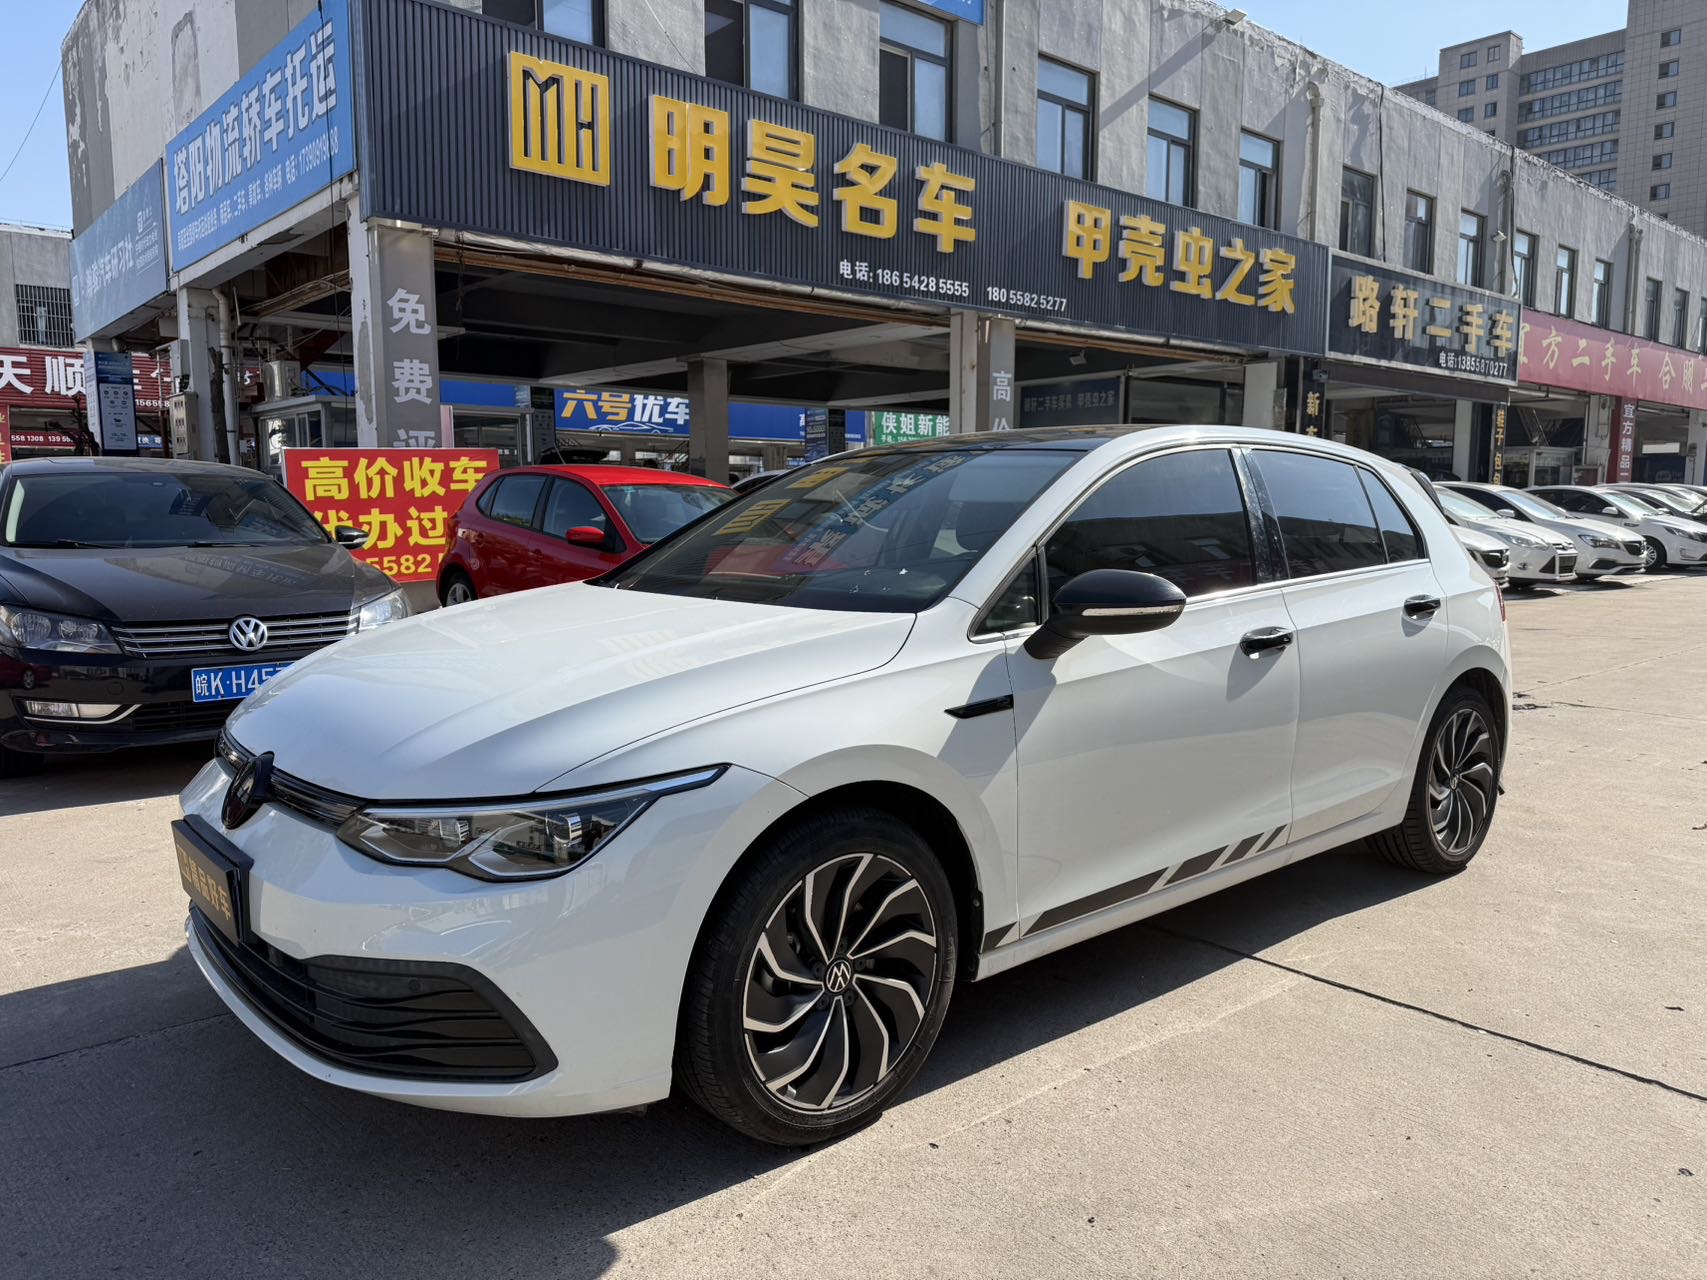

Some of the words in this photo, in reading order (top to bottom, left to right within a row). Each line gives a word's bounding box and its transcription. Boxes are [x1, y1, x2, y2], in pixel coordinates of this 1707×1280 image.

[648, 93, 977, 254] 明昊名车
[1061, 199, 1297, 315] 甲壳虫之家
[876, 268, 900, 286] 186
[902, 272, 936, 292] 5428
[938, 278, 970, 297] 5555
[986, 286, 1007, 302] 180
[1009, 290, 1038, 308] 5582
[1040, 294, 1067, 313] 5277
[1348, 274, 1514, 358] 路轩二手车
[560, 388, 690, 425] 六号优车
[300, 456, 488, 501] 高价收车
[195, 667, 284, 697] 皖K·H45
